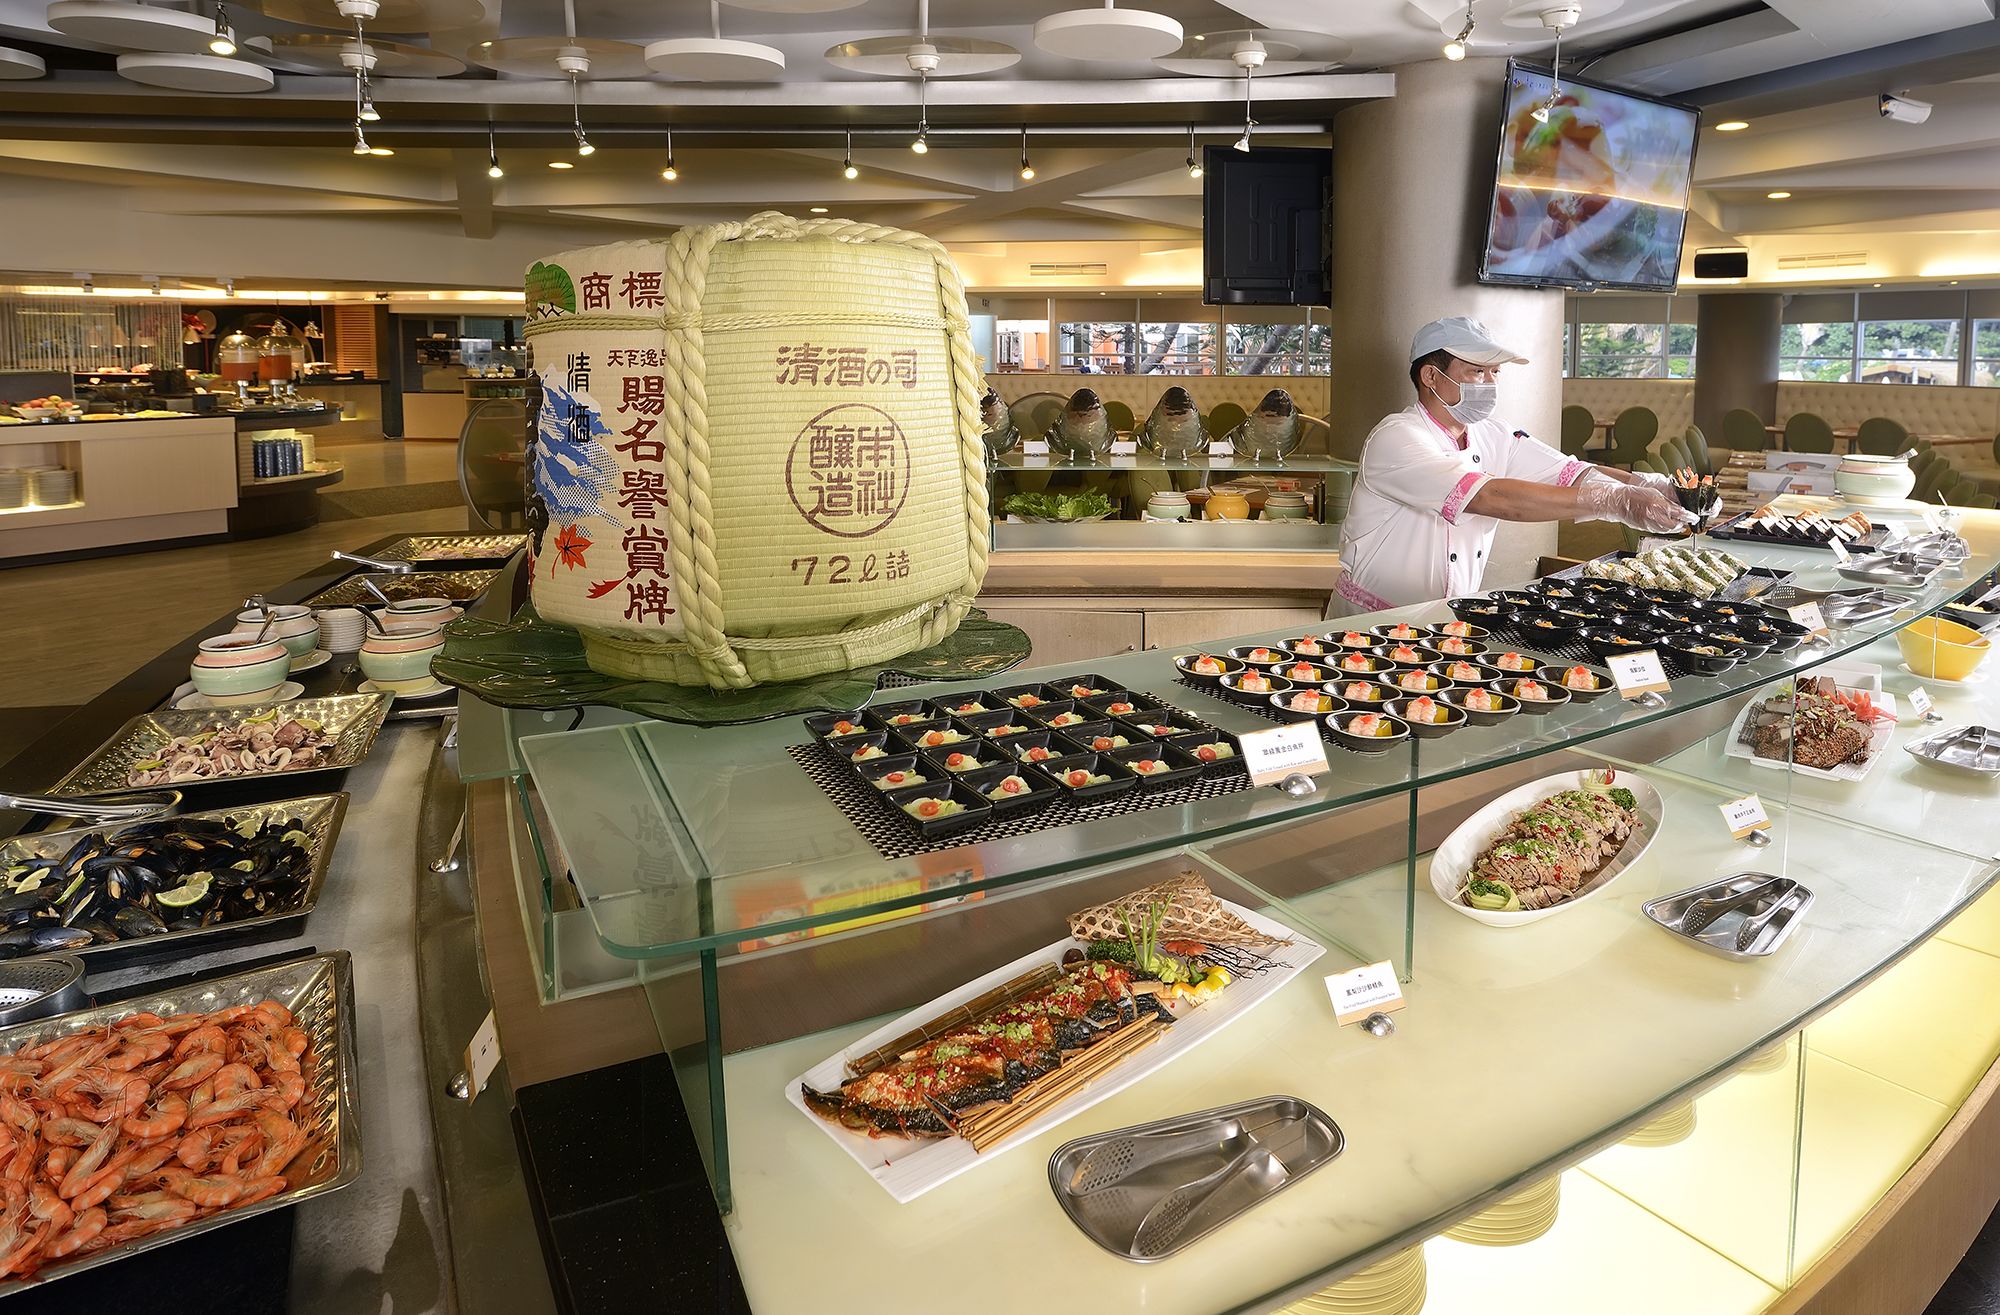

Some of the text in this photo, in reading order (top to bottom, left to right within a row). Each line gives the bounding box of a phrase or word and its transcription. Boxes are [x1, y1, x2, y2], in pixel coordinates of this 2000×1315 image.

[579, 270, 666, 312] 商標
[567, 351, 591, 443] 清酒
[775, 342, 918, 389] 清酒の司
[614, 375, 676, 626] 賜名譽賞牌
